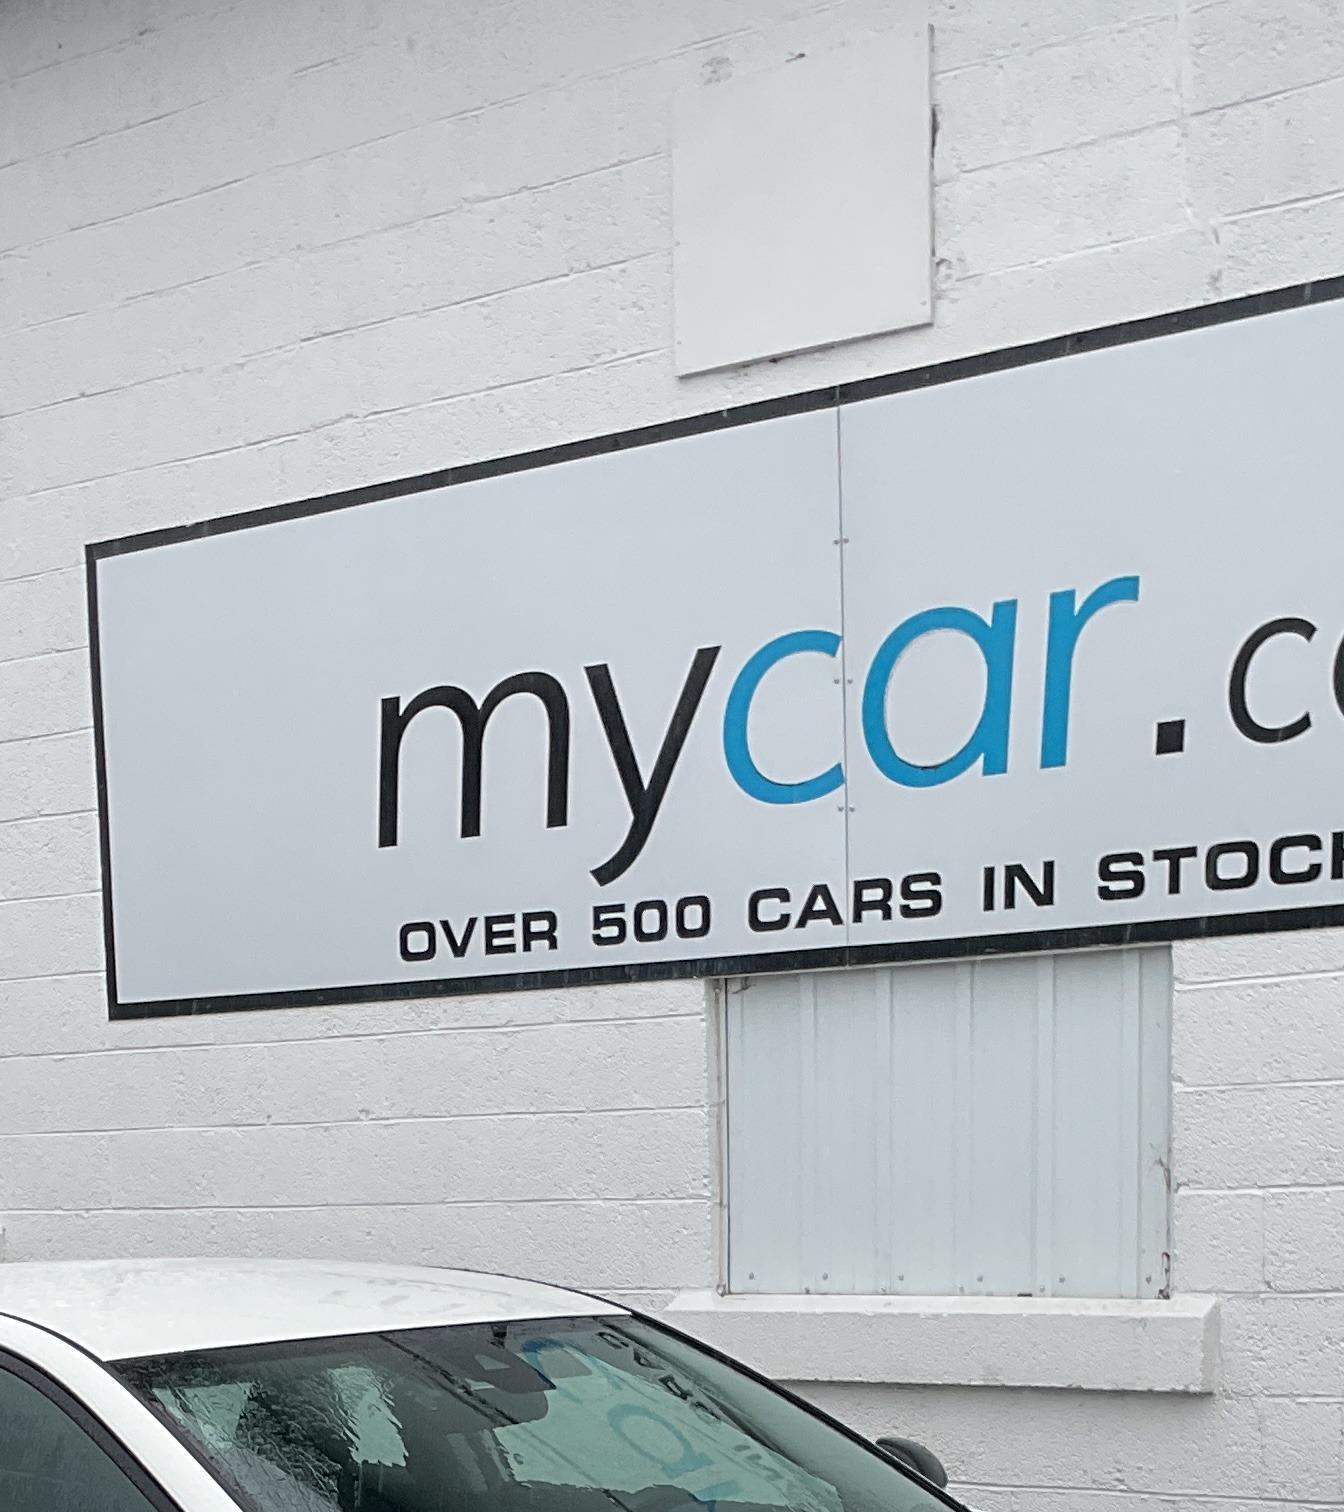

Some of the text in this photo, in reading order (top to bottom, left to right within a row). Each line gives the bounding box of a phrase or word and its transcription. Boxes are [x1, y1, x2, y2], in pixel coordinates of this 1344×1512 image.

[399, 911, 558, 962] OVER
[592, 896, 711, 947] 500
[748, 873, 943, 933] CARS
[983, 861, 1056, 911] IN
